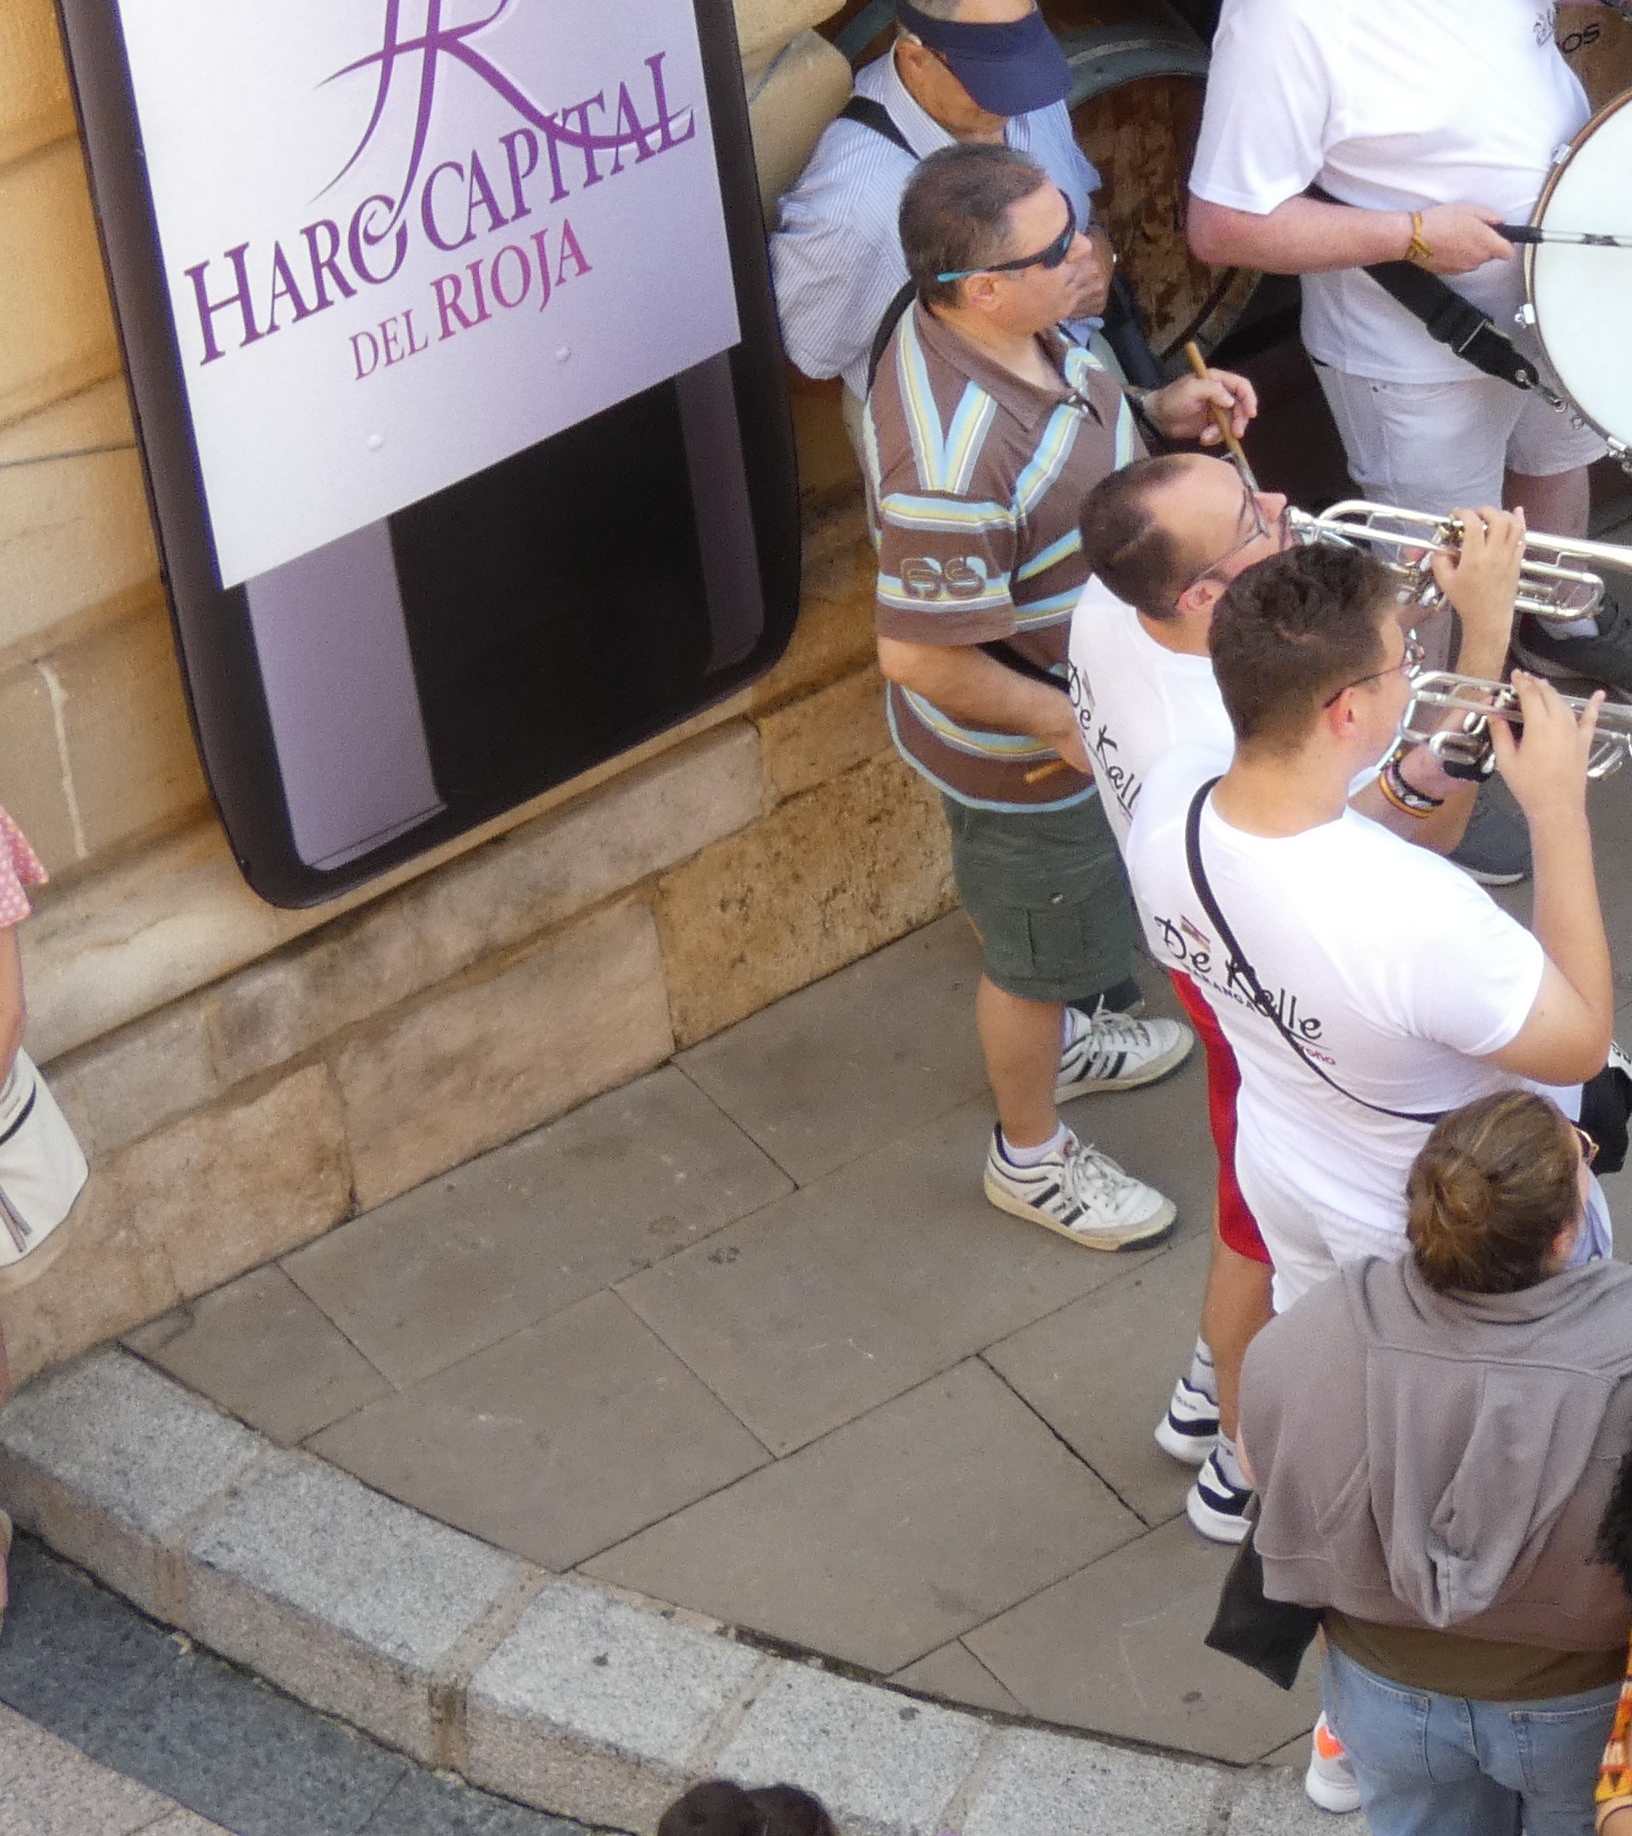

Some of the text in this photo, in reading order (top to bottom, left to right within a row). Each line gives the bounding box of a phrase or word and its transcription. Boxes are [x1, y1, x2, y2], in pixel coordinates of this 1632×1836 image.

[184, 51, 697, 365] HARO CAPITAL
[348, 217, 593, 382] DEL RIOJA
[1096, 723, 1142, 811] Kall
[1154, 915, 1213, 974] De
